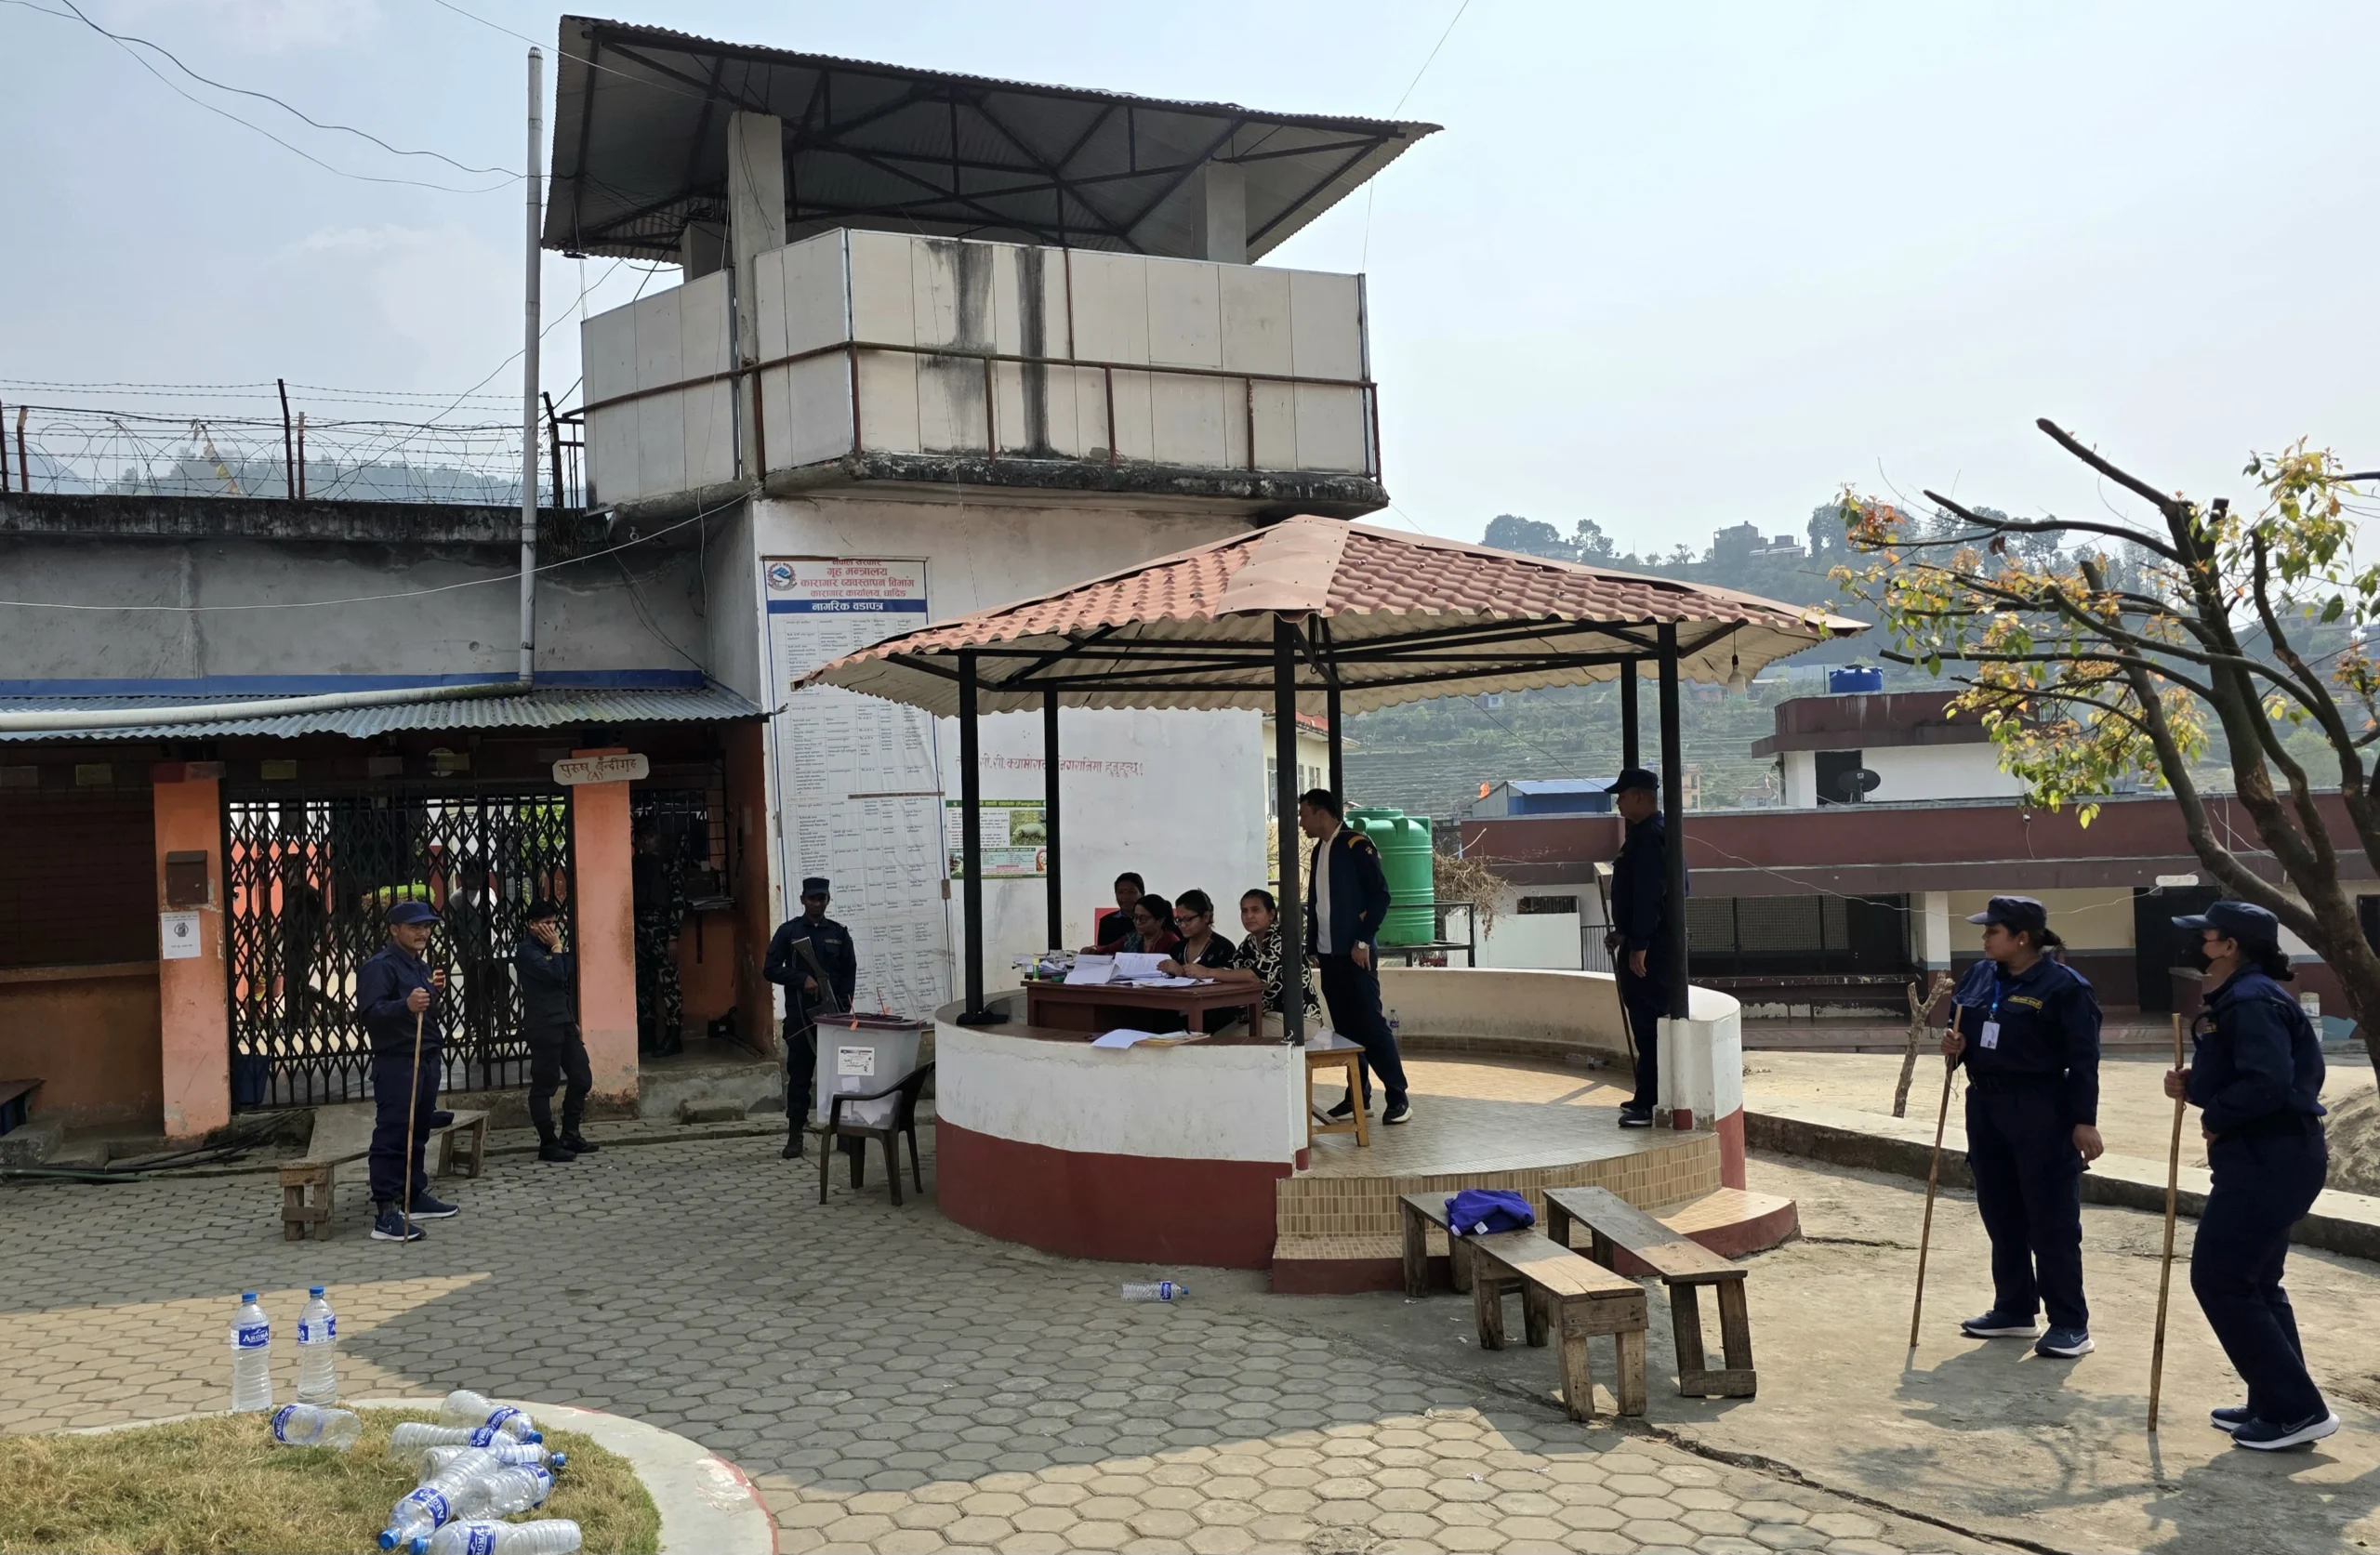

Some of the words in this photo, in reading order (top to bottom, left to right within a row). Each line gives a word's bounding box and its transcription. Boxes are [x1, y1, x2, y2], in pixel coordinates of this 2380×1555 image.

[826, 567, 842, 577] गृह
[845, 568, 888, 576] मन्त्रालय
[800, 579, 839, 587] कारागार
[811, 589, 844, 598] कारागार
[812, 600, 850, 611] नागरिक
[853, 602, 884, 611] वडापत्र
[587, 771, 603, 782] (A)
[242, 1329, 269, 1342] AROMA
[418, 1491, 444, 1519] AROMA
[474, 1527, 484, 1555] ROMA
